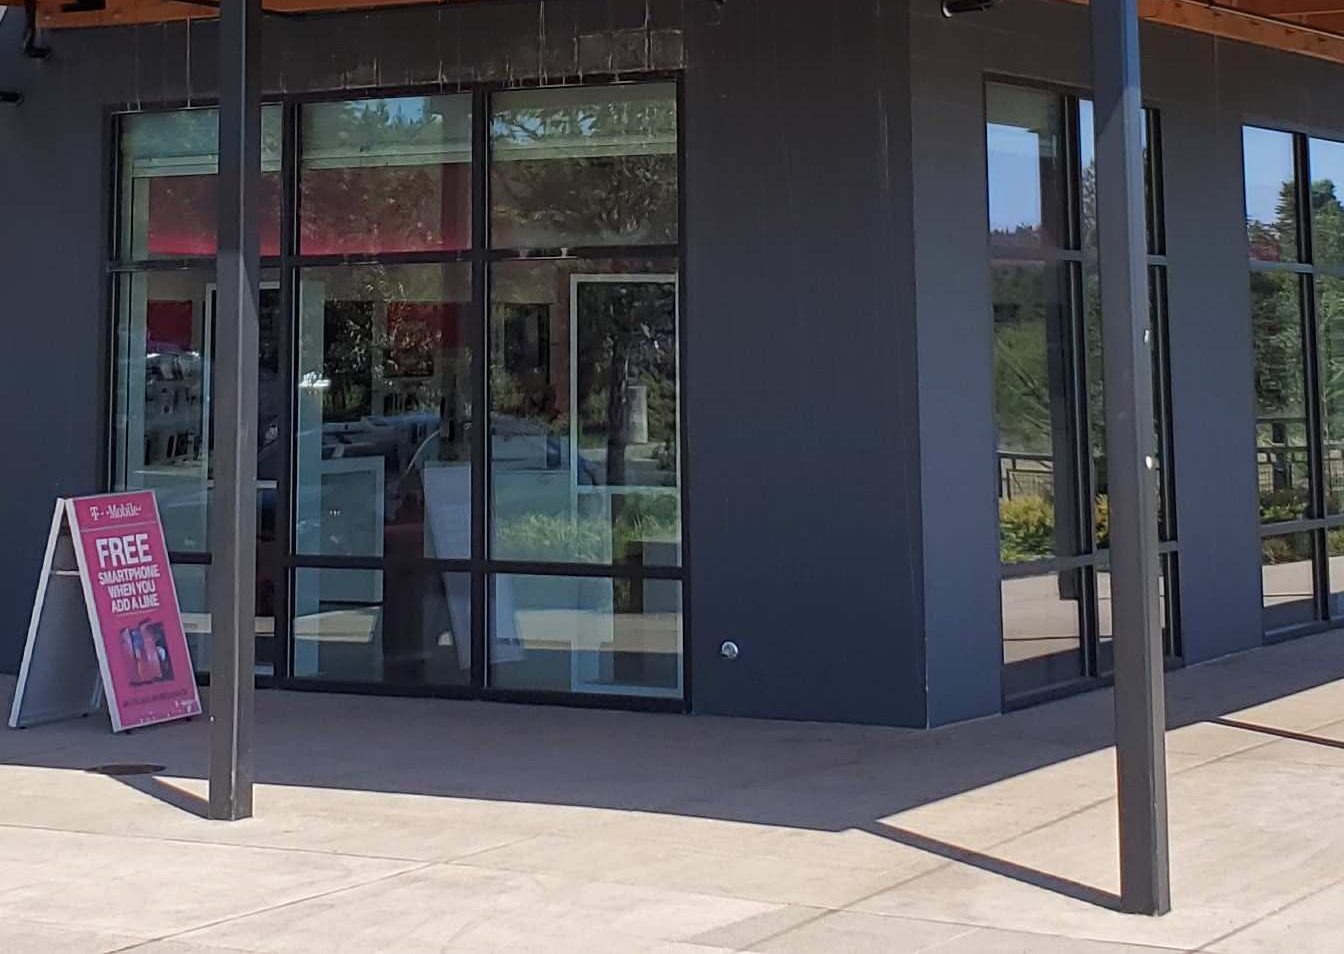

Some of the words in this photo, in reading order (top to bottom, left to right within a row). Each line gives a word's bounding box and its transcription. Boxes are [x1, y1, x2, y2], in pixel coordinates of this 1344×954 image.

[96, 533, 153, 568] FREE
[98, 564, 161, 585] SMARTPHONE
[107, 582, 137, 599] WHEN
[135, 580, 156, 595] YOU
[111, 597, 131, 614] ADD
[131, 597, 140, 611] A
[139, 593, 161, 609] LINE
